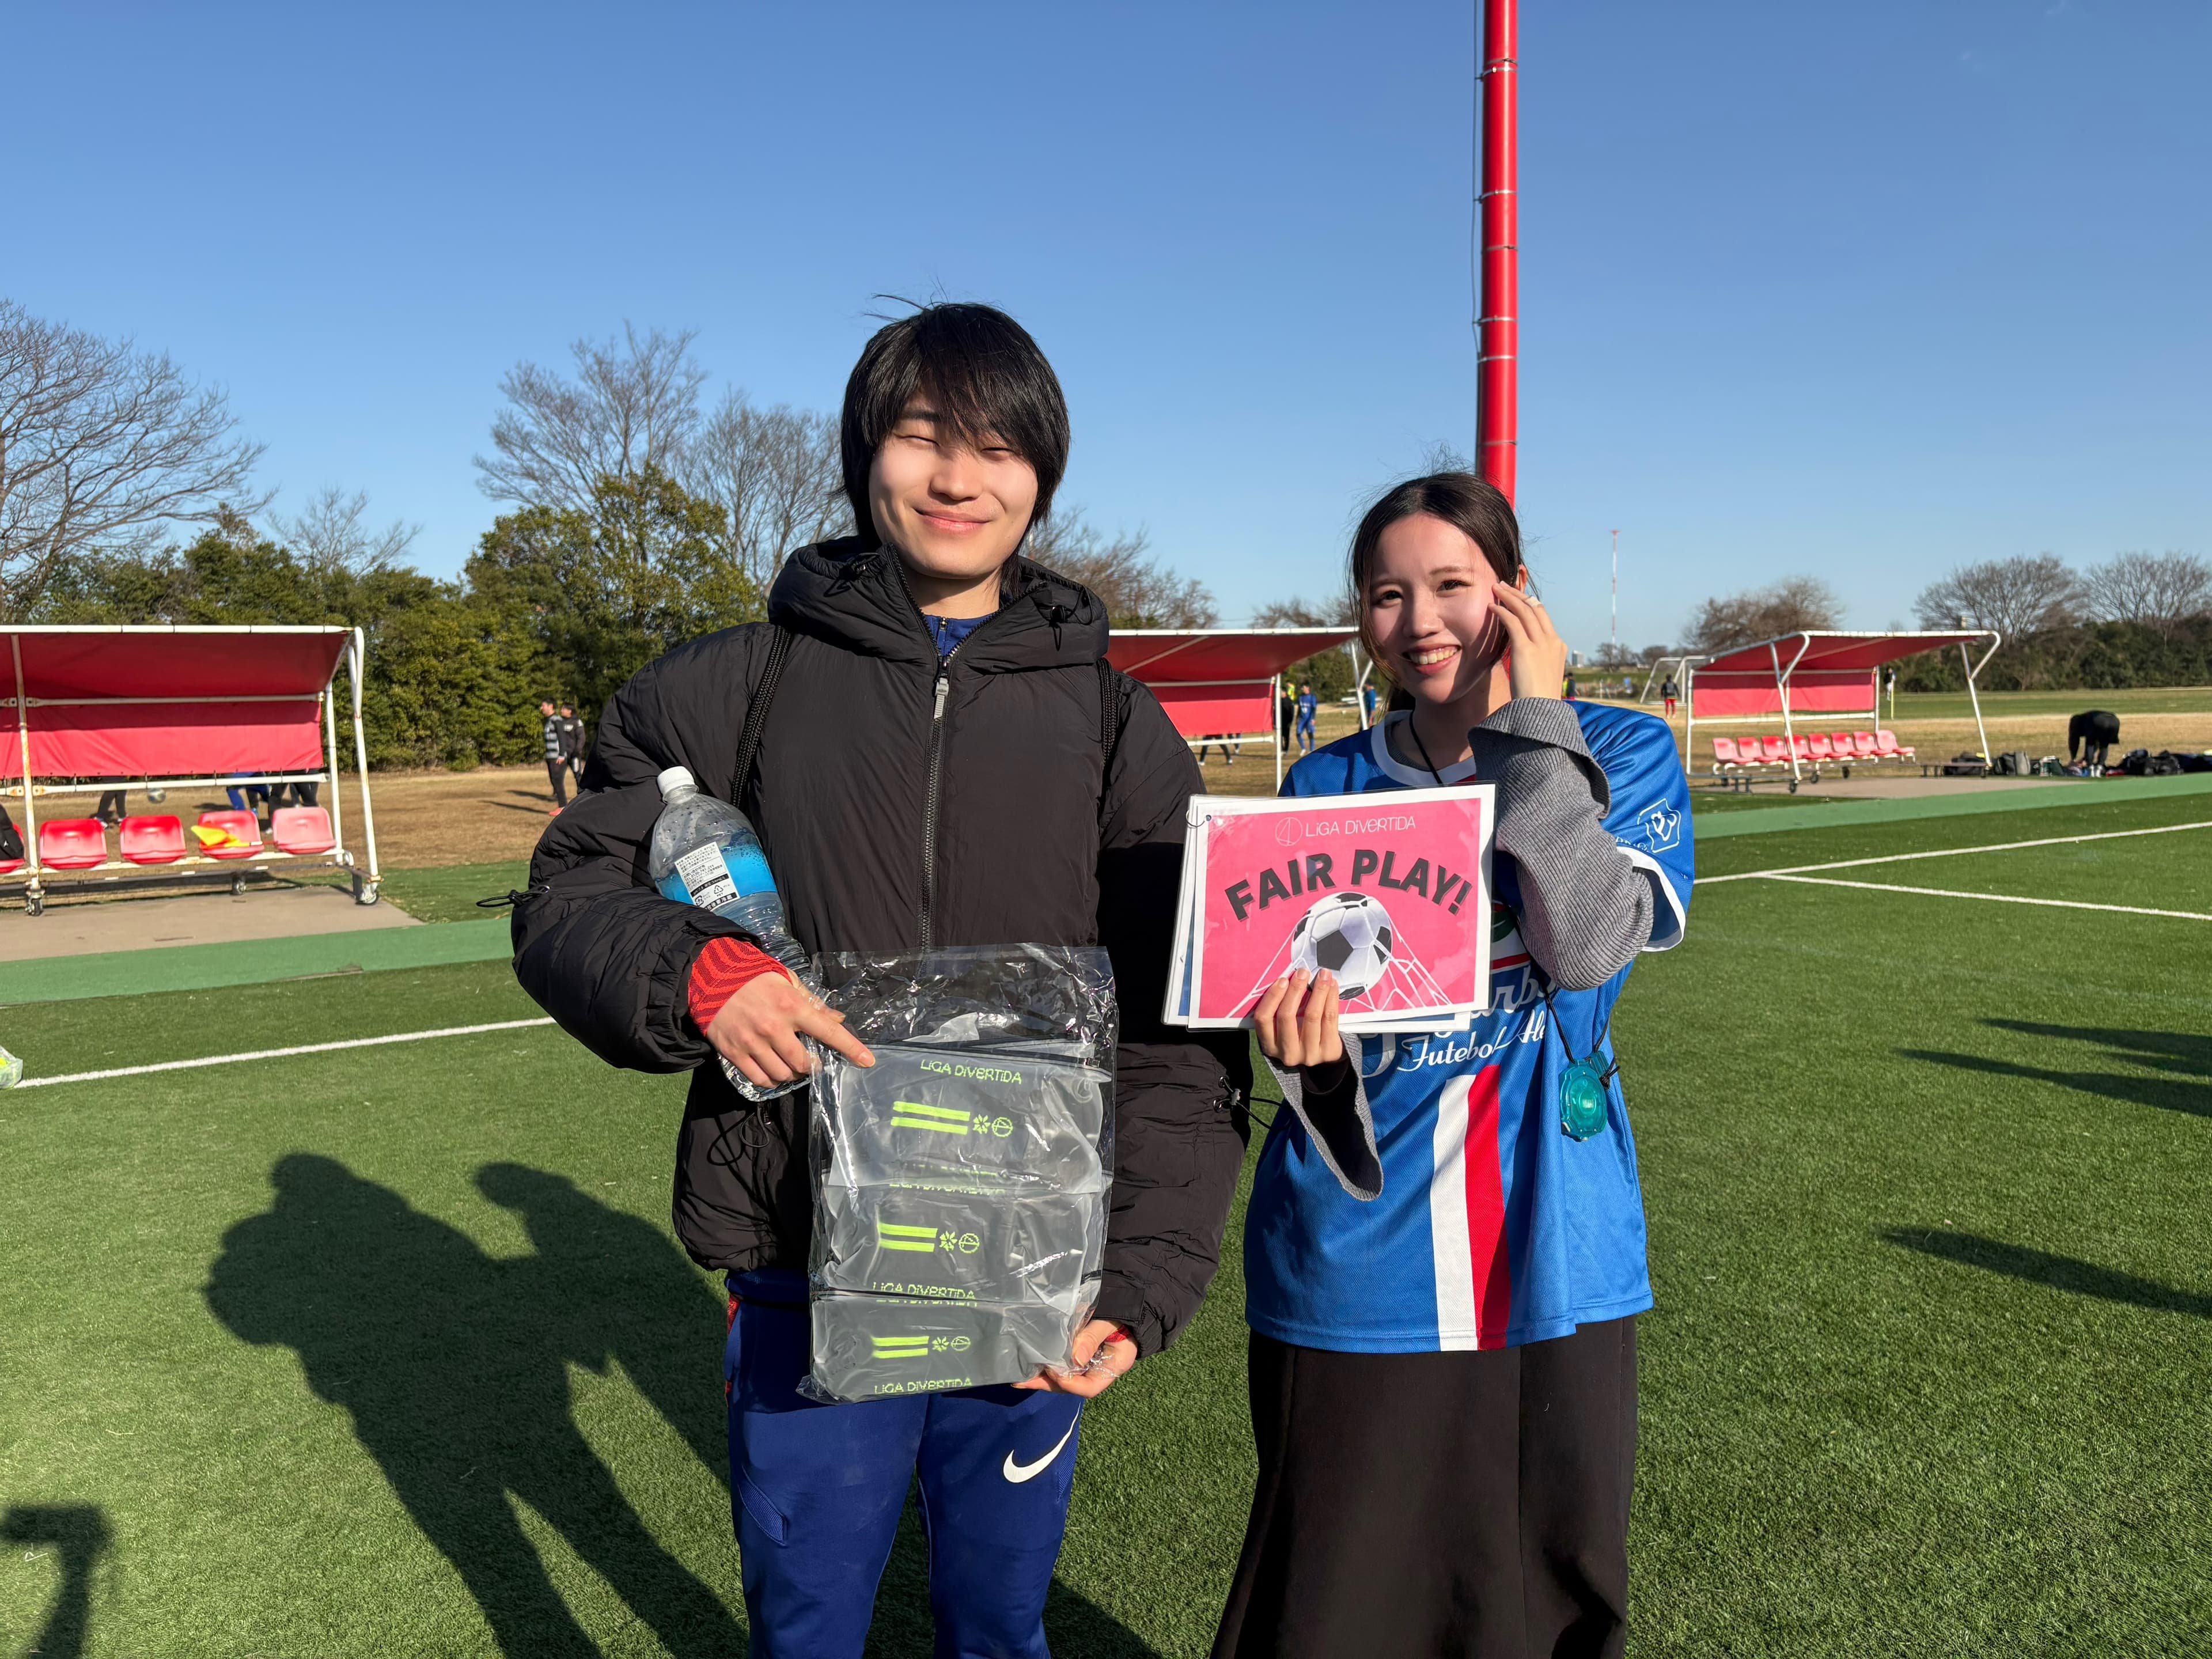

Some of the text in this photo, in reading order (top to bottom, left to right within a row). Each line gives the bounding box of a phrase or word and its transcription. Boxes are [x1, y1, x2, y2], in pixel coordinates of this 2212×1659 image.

[1224, 849, 1472, 922] FAIR PLAY!
[1397, 1026, 1517, 1071] Futebol
